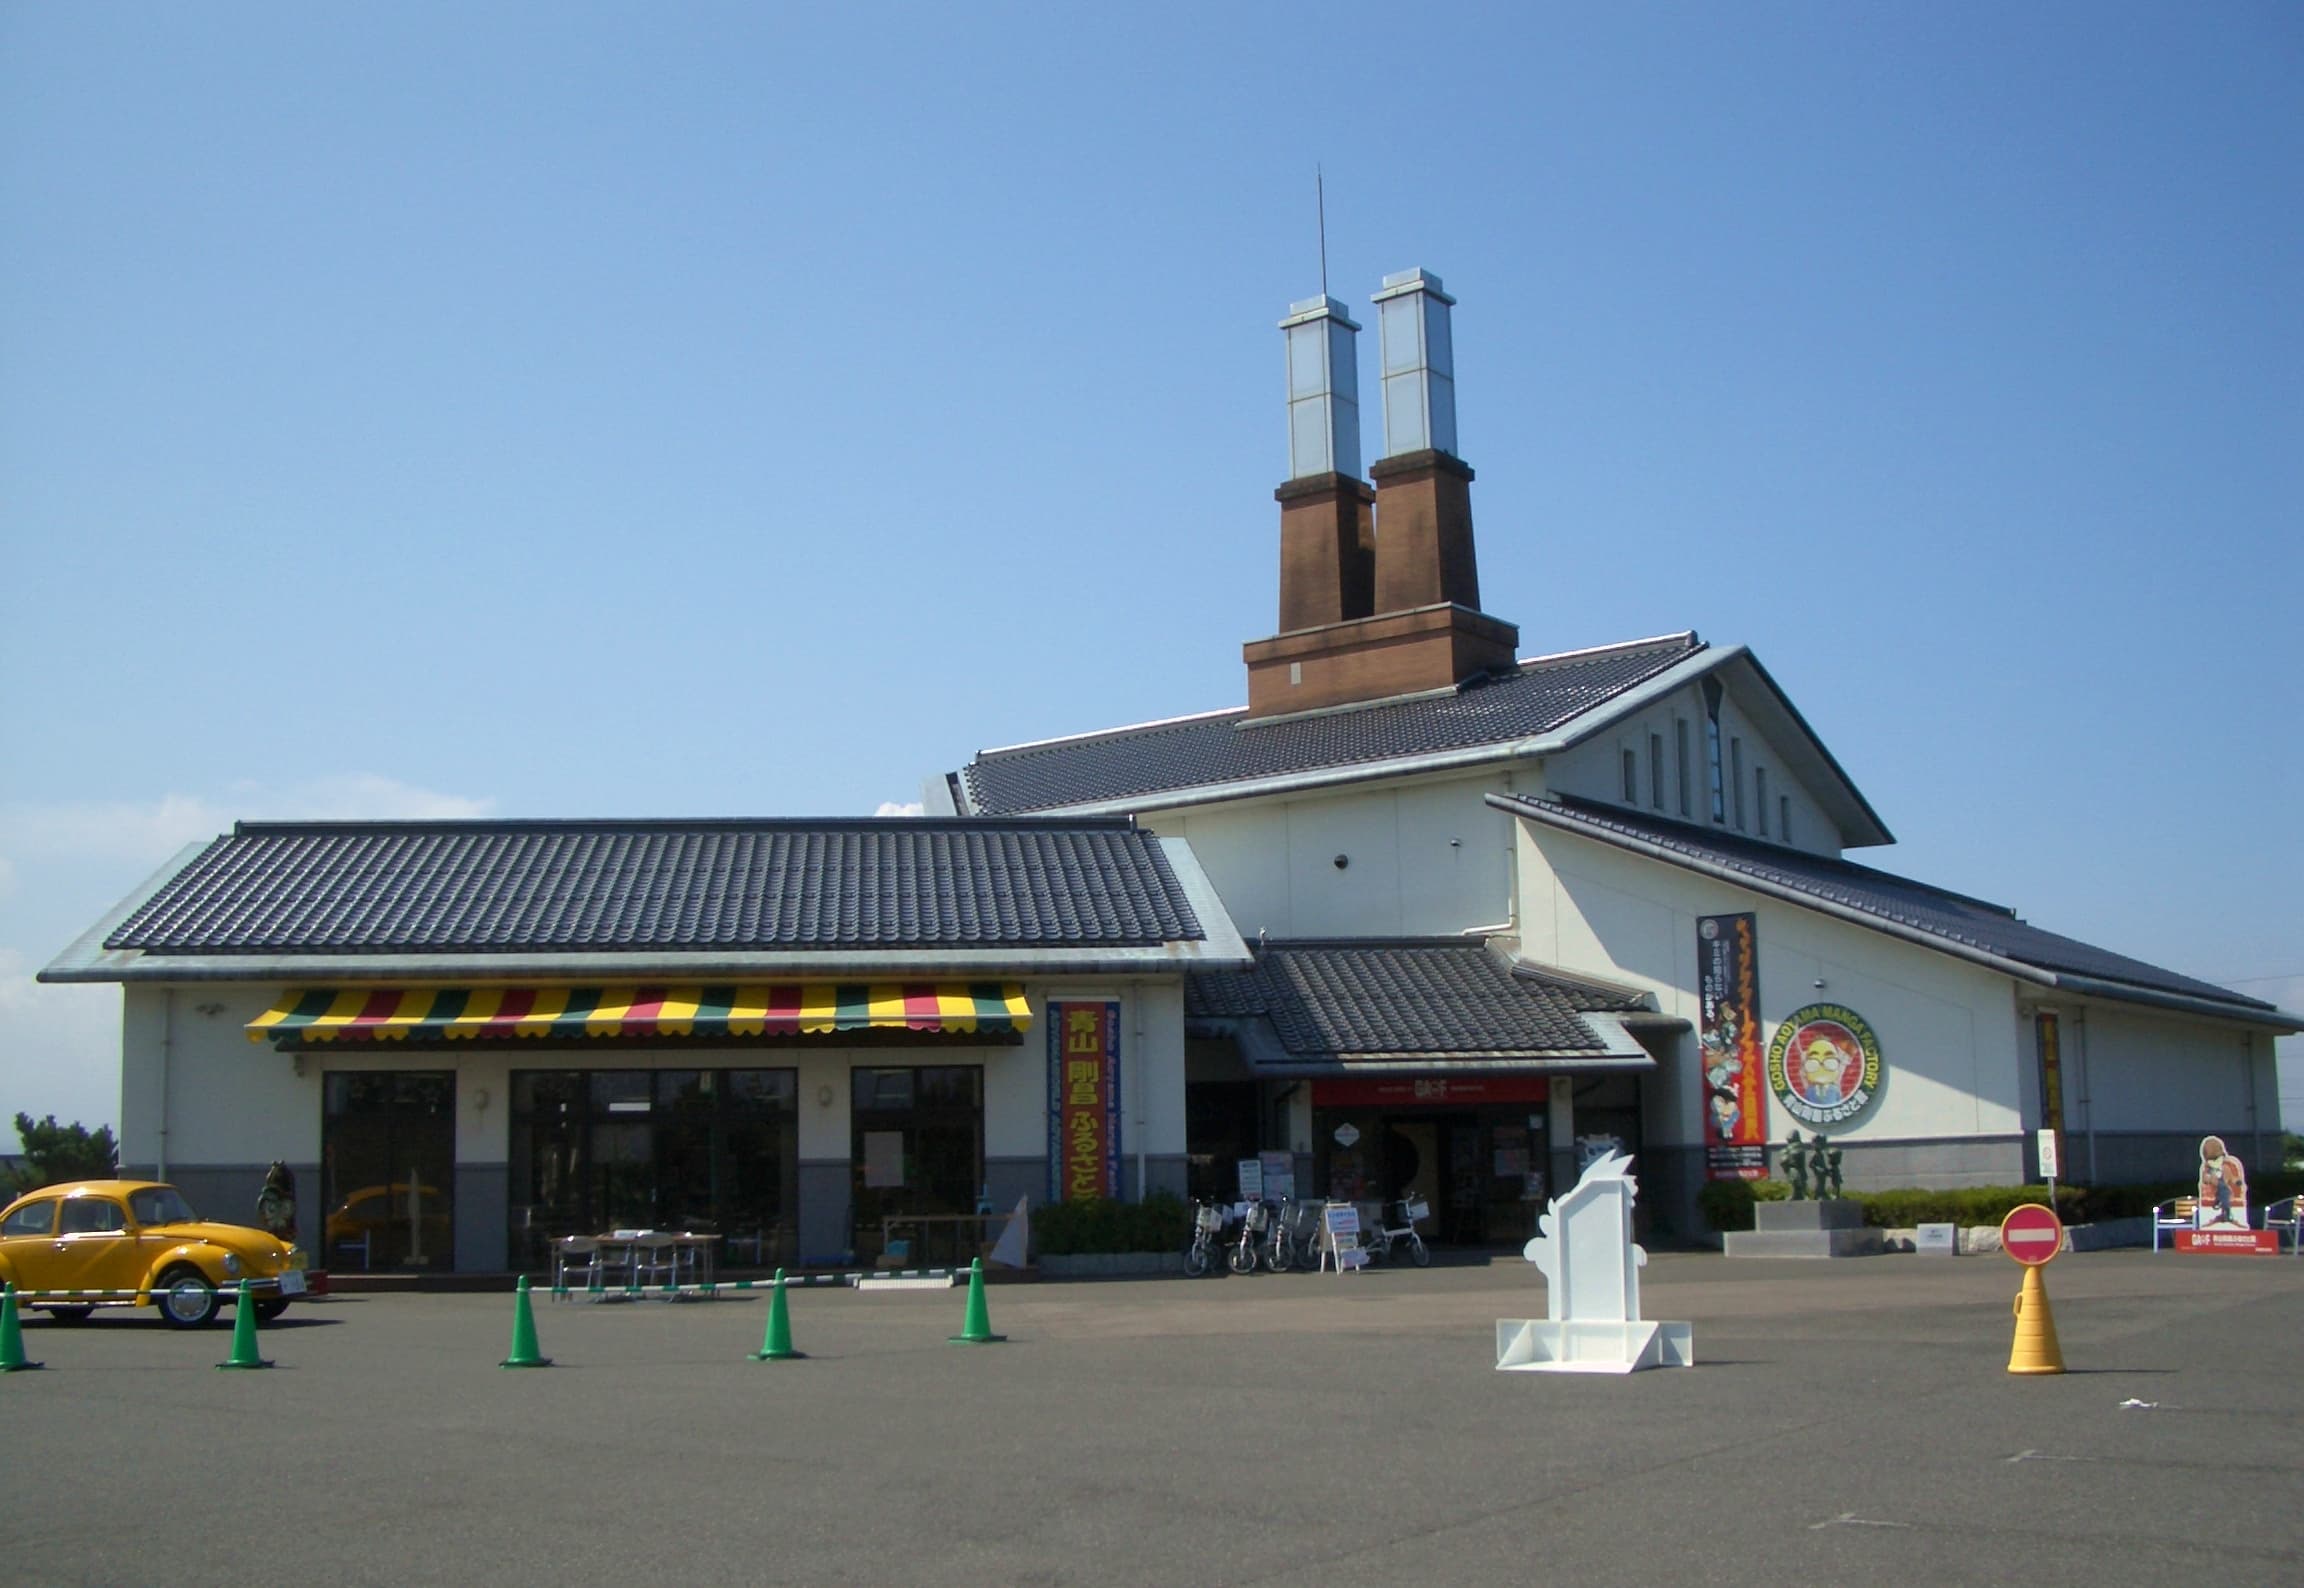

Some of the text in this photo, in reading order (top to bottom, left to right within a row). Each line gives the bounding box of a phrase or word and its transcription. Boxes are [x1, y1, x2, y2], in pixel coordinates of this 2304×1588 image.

[1769, 1045, 1785, 1091] GOSHO
[1822, 1005, 1865, 1034] MANGA
[1860, 1031, 1879, 1089] FACTORY
